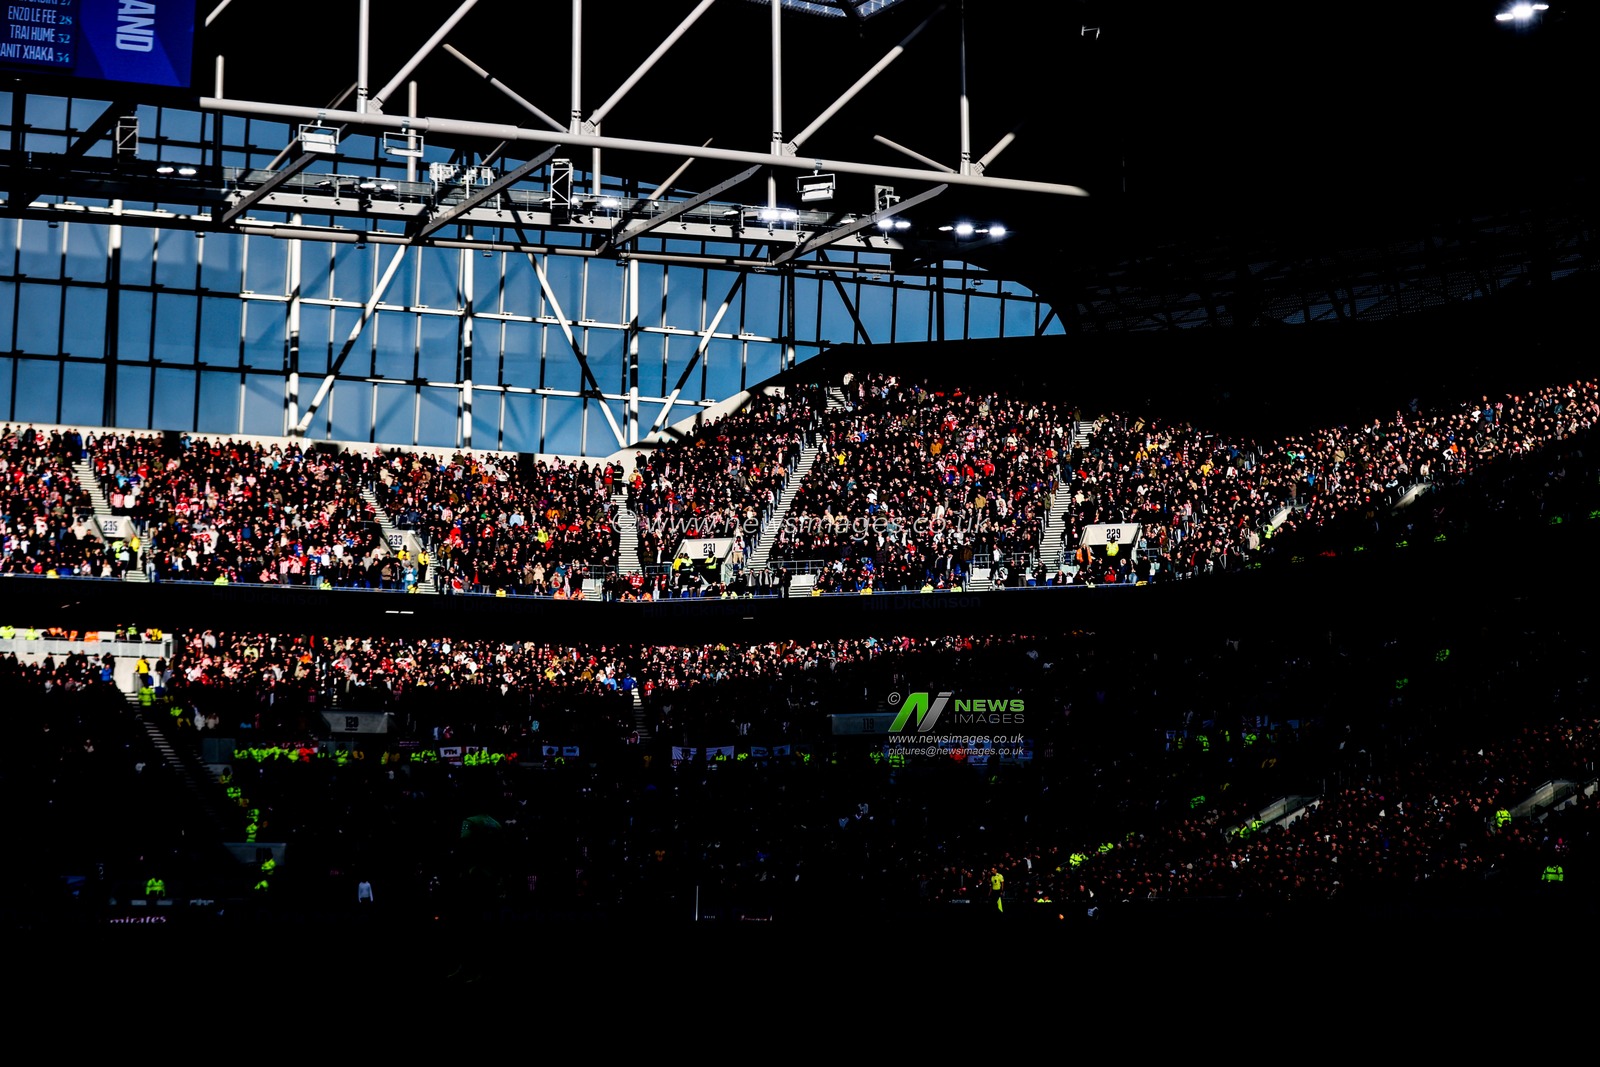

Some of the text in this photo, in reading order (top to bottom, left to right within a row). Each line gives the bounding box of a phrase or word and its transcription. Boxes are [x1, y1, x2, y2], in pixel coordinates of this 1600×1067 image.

[8, 5, 73, 26] ENZO LE FEE 28
[10, 24, 30, 40] TRAI
[31, 26, 56, 43] HUME
[0, 42, 22, 58] ANIT
[22, 44, 54, 62] XHAKA
[389, 534, 403, 545] 233
[1106, 528, 1121, 539] 229
[703, 543, 716, 554] 231
[862, 717, 875, 730] 119
